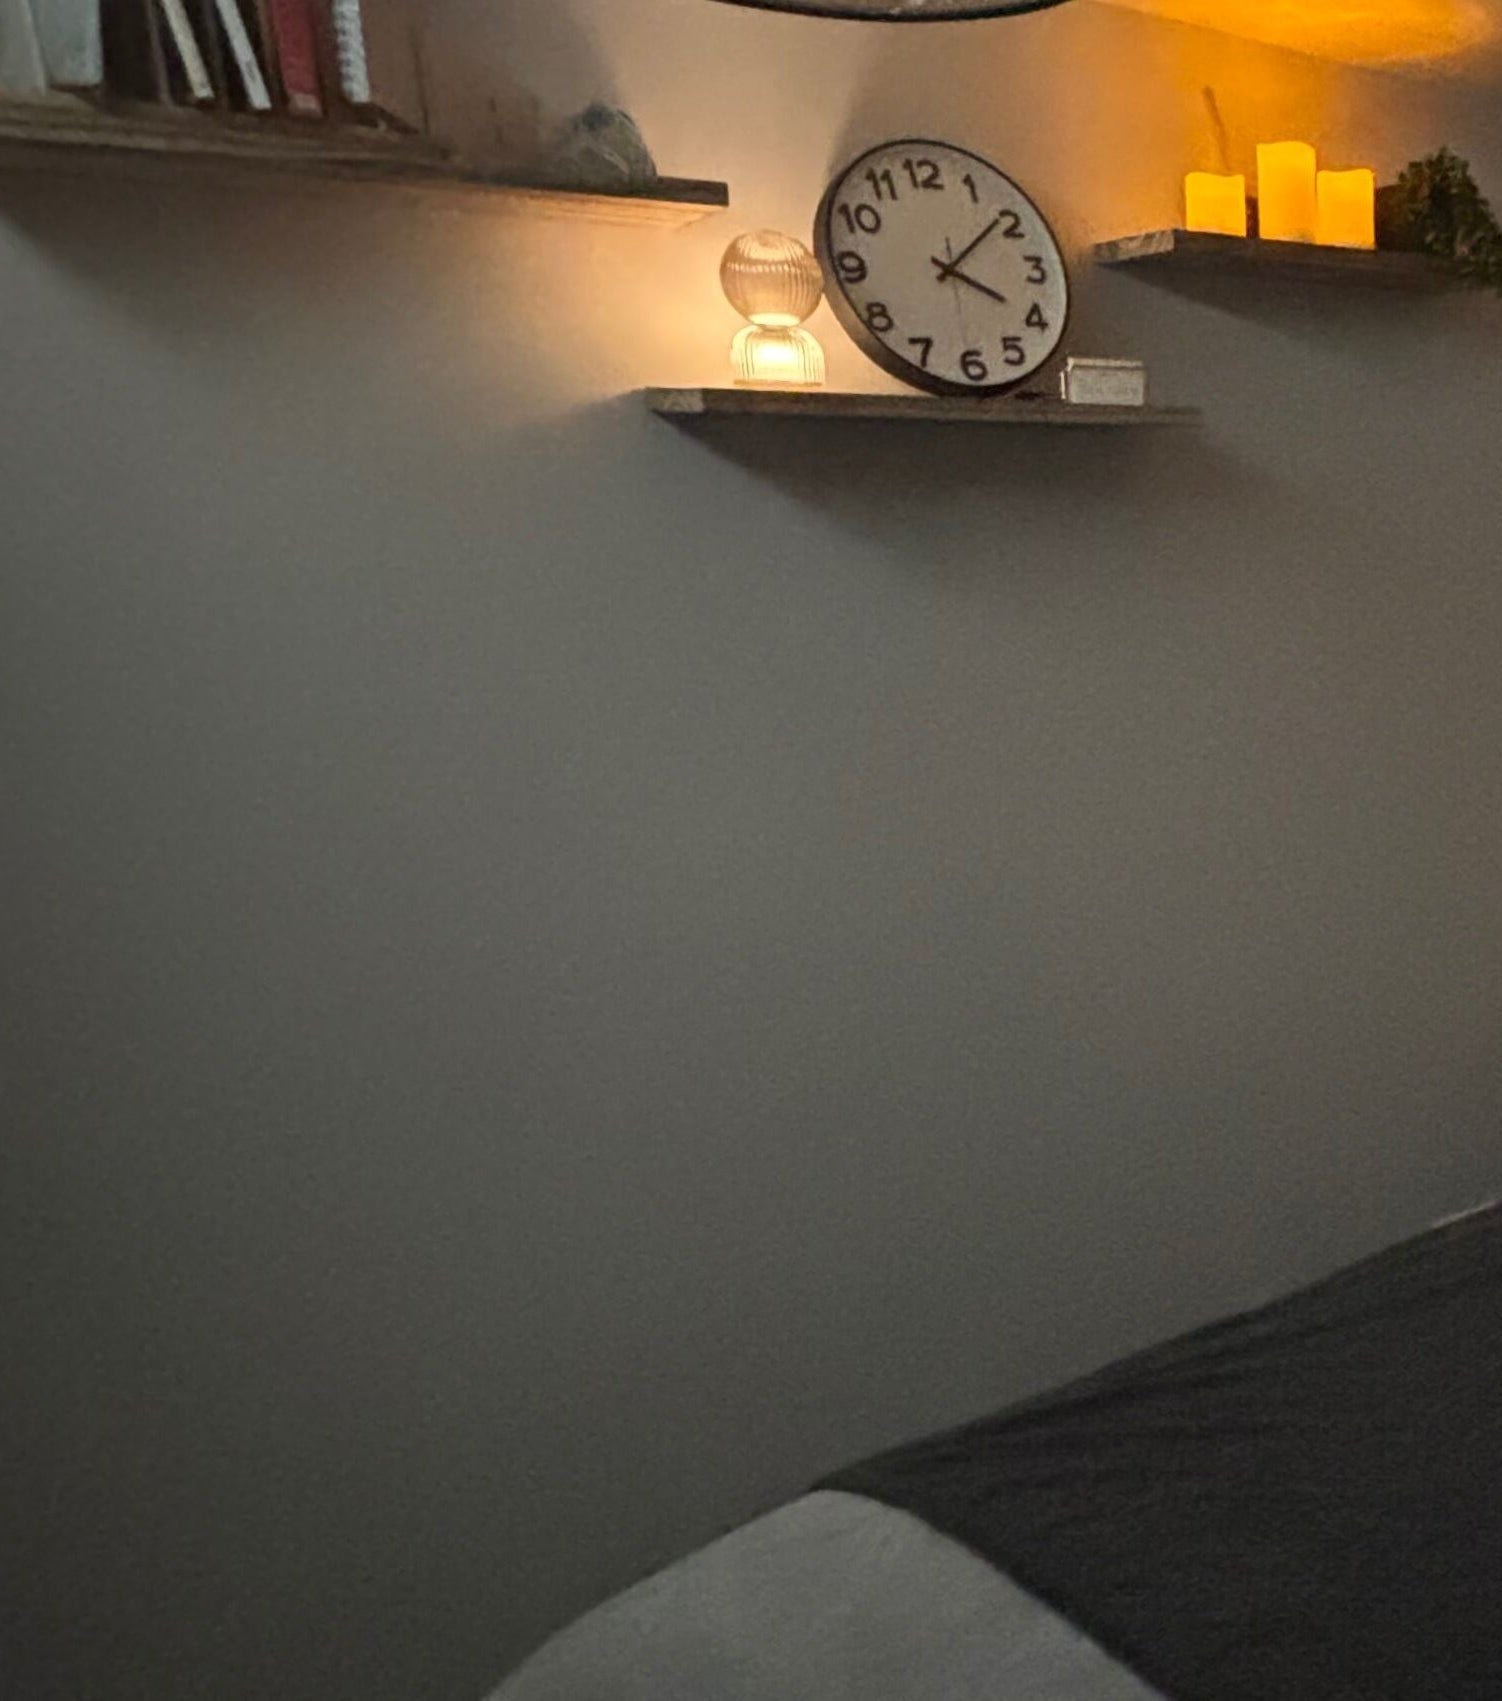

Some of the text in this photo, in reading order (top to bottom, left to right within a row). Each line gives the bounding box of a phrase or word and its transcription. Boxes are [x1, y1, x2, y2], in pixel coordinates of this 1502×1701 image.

[865, 167, 897, 201] 11
[903, 159, 943, 190] 12
[963, 174, 979, 203] 1
[838, 203, 881, 234] 10
[998, 209, 1024, 239] 2
[836, 251, 867, 283] 9
[1024, 256, 1046, 284] 3
[866, 302, 894, 333] 8
[1025, 303, 1049, 333] 4
[908, 337, 935, 368] 7
[960, 350, 987, 381] 6
[1002, 336, 1025, 366] 5
